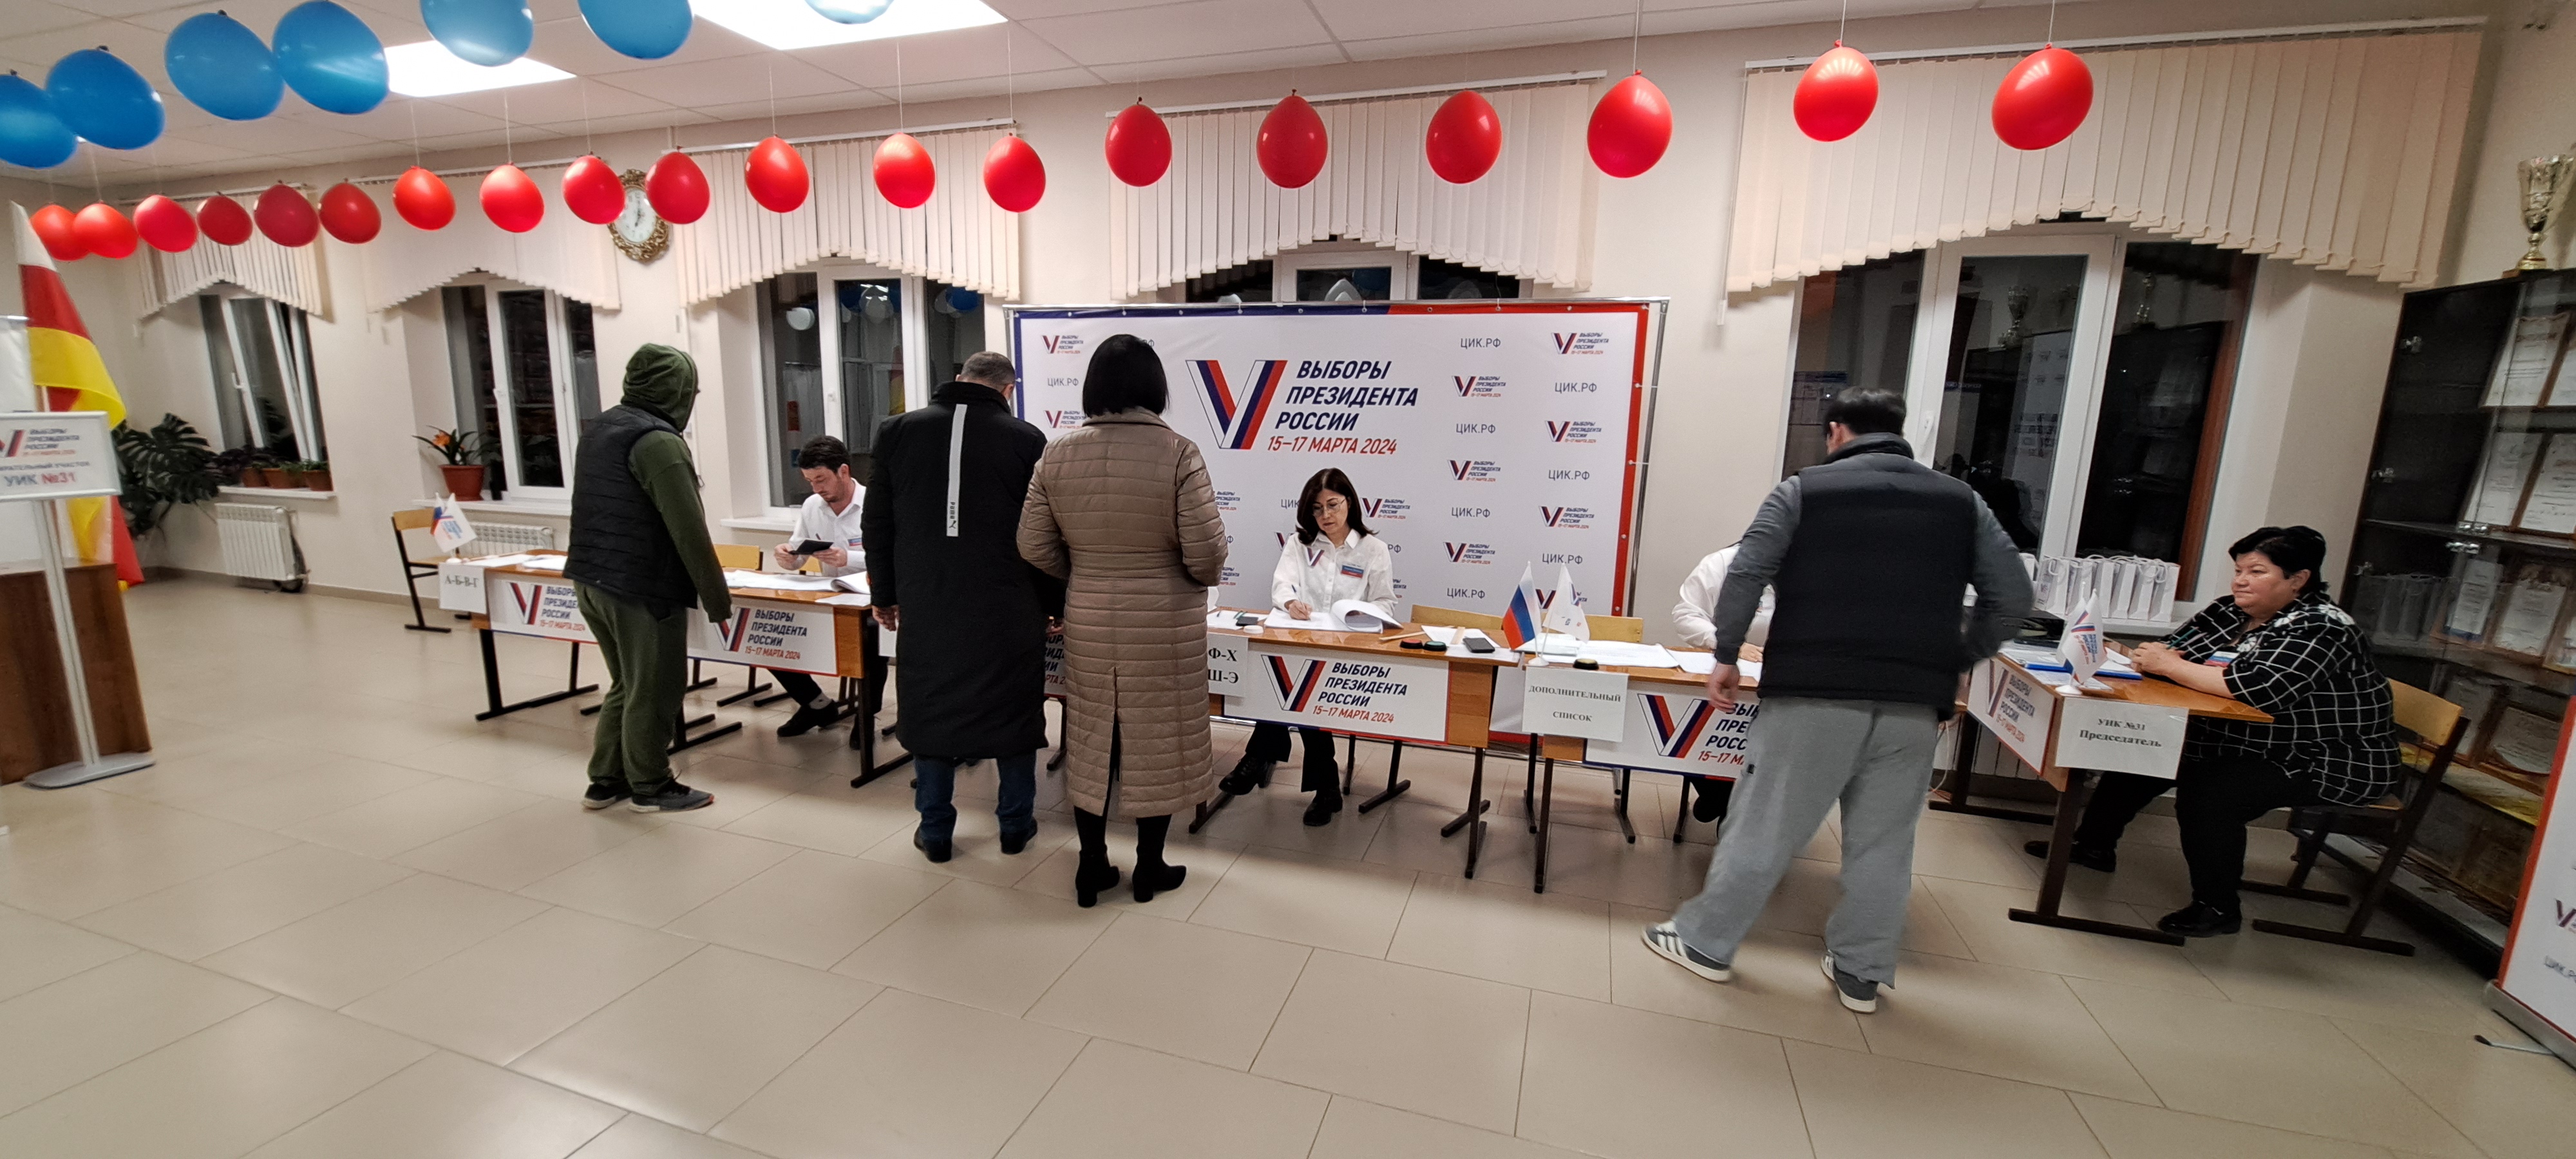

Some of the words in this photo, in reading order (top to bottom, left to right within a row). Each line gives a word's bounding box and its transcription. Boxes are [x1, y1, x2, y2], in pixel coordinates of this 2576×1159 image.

[1461, 338, 1501, 349] ЦИК.РФ
[1296, 361, 1392, 379] ВЫБОРЫ
[1048, 378, 1079, 387] ЦИК.РФ
[1555, 382, 1597, 393] ЦИК.РФ
[1285, 386, 1419, 408] ПРЕЗИДЕНТА
[1274, 411, 1359, 431] РОССИИ
[1456, 424, 1496, 435] ЦИК.РФ
[1267, 436, 1309, 451] 15–17
[1308, 437, 1358, 453] МАРТА
[1359, 438, 1397, 455] 2024
[1548, 469, 1590, 480] ЦИК.РФ
[1281, 499, 1300, 509] ЦИК
[1451, 507, 1490, 518] ЦИК.РФ
[1542, 553, 1583, 565] ЦИК.РФ
[1447, 588, 1485, 599] ЦИК.РФ
[544, 598, 578, 608] ПРЕЗИДЕ
[542, 609, 571, 619] РОССИИ
[755, 609, 794, 623] ВЫБОРЫ
[751, 622, 807, 637] ПРЕЗИДЕНТА
[747, 634, 783, 646] РОССИИ
[745, 646, 762, 655] 15–17
[762, 647, 784, 658] МАРТА
[784, 650, 800, 660] 2024
[1208, 647, 1238, 662] Ф-Х
[1331, 662, 1391, 678] ВЫБОРЫ
[1325, 677, 1408, 696] ПРЕЗИДЕНТА
[1318, 692, 1371, 708] РОССИИ
[1528, 685, 1622, 702] ДОПОЛНИТЕЛЬНЫЙ
[1312, 705, 1338, 717] 15–17
[1338, 709, 1370, 721] МАРТА
[1371, 711, 1395, 723] 2024
[1553, 711, 1593, 722] СПИСОК
[2098, 718, 2123, 728] УИК
[2124, 721, 2146, 731] №31
[1705, 735, 1748, 751] РОСС
[2079, 730, 2162, 748] Председатель
[1698, 751, 1731, 763] 15–17
